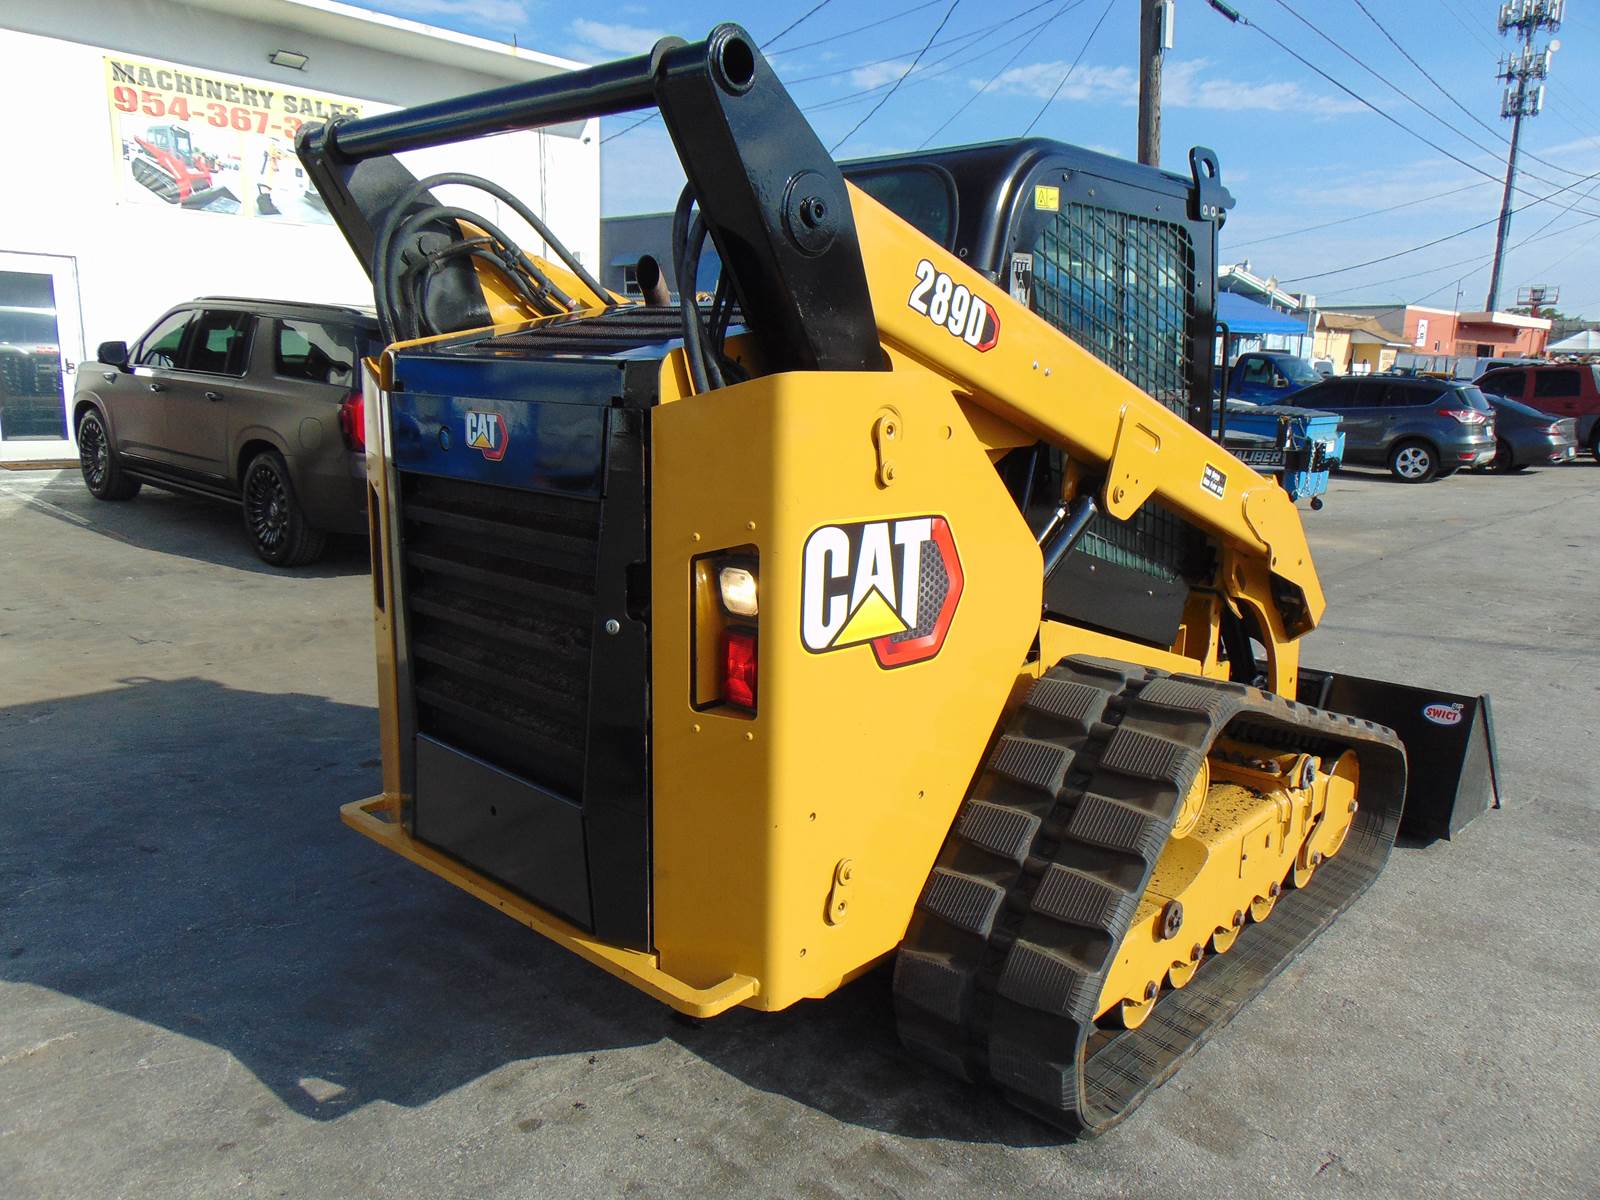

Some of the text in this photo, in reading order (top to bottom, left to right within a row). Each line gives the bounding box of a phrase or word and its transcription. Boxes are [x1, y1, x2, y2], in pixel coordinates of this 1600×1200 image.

[111, 61, 274, 110] MACHINERY
[908, 258, 990, 349] 289D
[465, 411, 498, 449] CAT
[803, 517, 932, 650] CAT
[1426, 707, 1458, 721] SWICT
